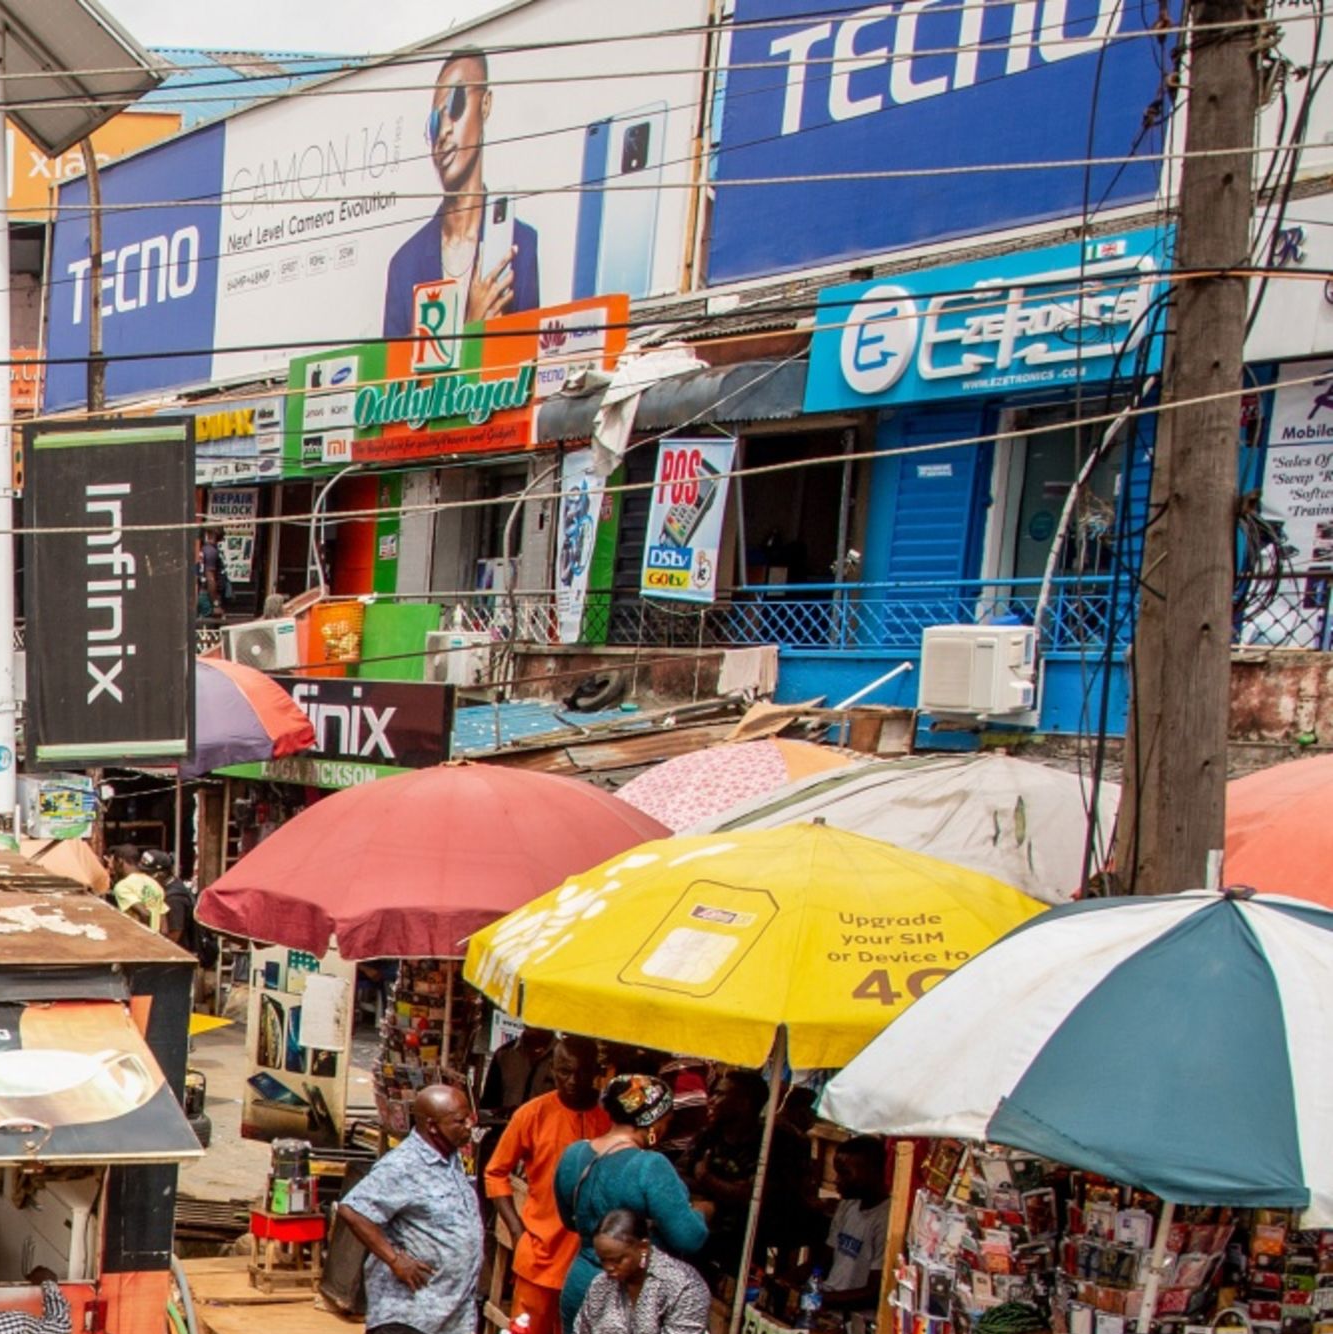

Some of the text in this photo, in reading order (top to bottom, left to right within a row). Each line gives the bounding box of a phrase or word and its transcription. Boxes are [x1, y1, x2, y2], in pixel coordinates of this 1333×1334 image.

[227, 189, 397, 253] Next Level Camera Evolution
[67, 225, 200, 325] TECNO
[657, 449, 702, 505] POS
[211, 504, 252, 515] UNLOCK
[85, 484, 138, 705] Infinix
[839, 912, 942, 929] Upgrade
[828, 948, 971, 963] or Device to
[841, 931, 945, 947] your SIM
